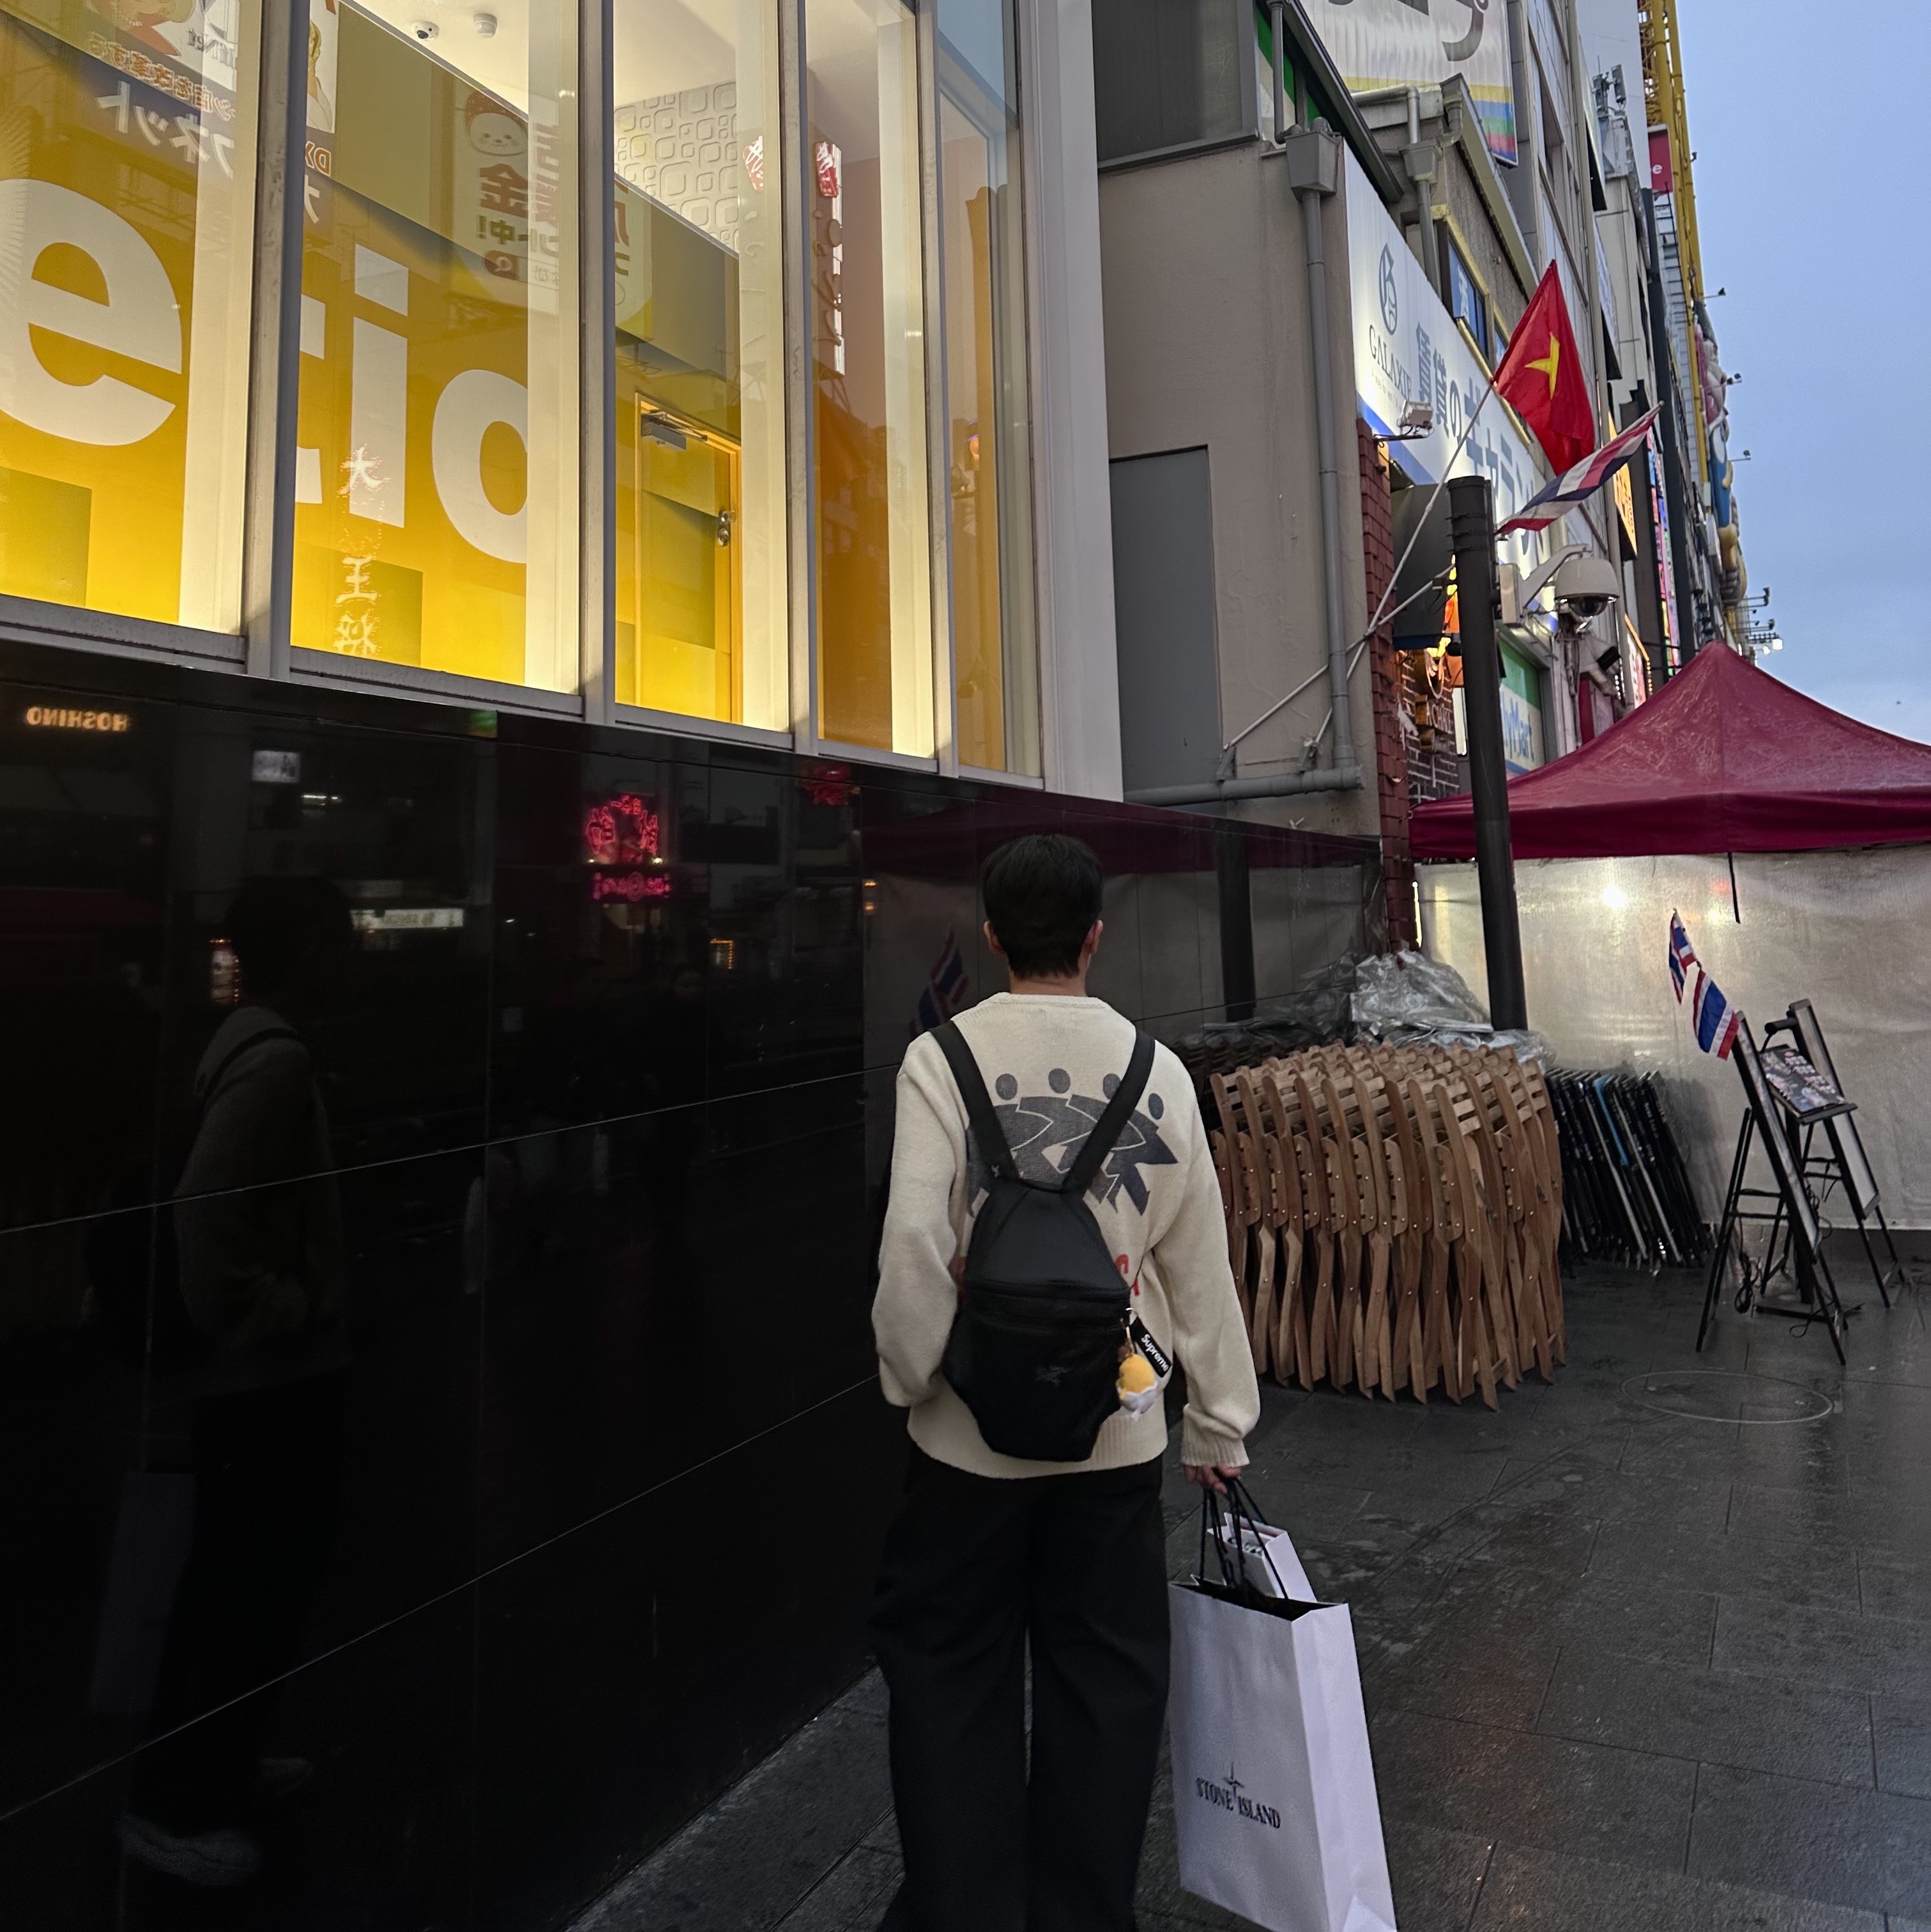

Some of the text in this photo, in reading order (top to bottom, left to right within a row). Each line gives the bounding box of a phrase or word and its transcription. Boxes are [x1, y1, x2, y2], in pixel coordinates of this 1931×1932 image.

[1141, 1333, 1170, 1372] Supreme
[1195, 1777, 1281, 1829] STONE ISLAND
